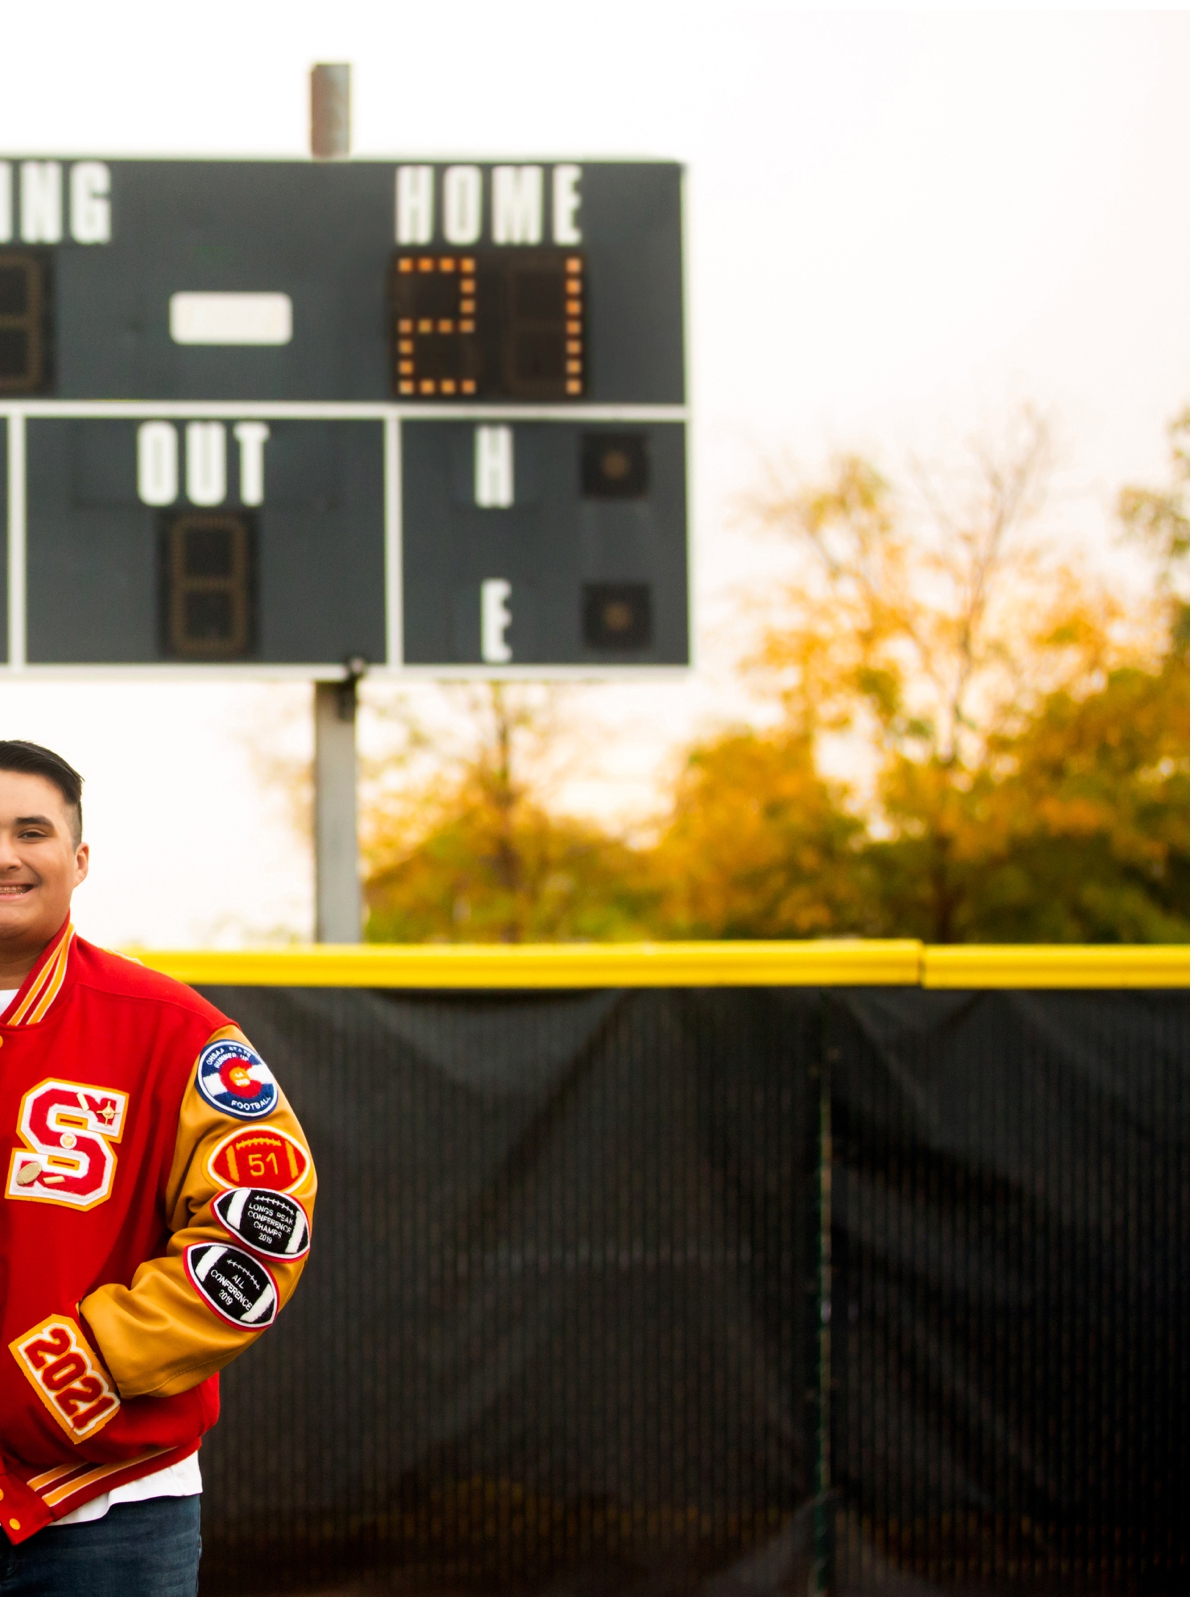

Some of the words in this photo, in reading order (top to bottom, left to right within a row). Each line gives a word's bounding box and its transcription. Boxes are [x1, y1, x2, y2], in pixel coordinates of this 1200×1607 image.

[395, 164, 583, 246] HOME
[398, 257, 582, 395] 21
[137, 421, 269, 506] OUT
[474, 425, 514, 509] H
[481, 578, 512, 663] E
[228, 1046, 251, 1057] STATE
[231, 1096, 272, 1111] FOOTBALL
[4, 1077, 130, 1212] S
[248, 1153, 279, 1177] 51
[247, 1211, 293, 1235] CONFERENCE
[248, 1203, 274, 1217] LONGS
[276, 1213, 294, 1225] PEAK
[253, 1221, 283, 1239] CHAMPS
[258, 1233, 273, 1245] 2019
[210, 1269, 253, 1311] CONFERENCE
[231, 1274, 245, 1289] ALL
[218, 1289, 234, 1306] 2019
[22, 1326, 118, 1434] 2021
